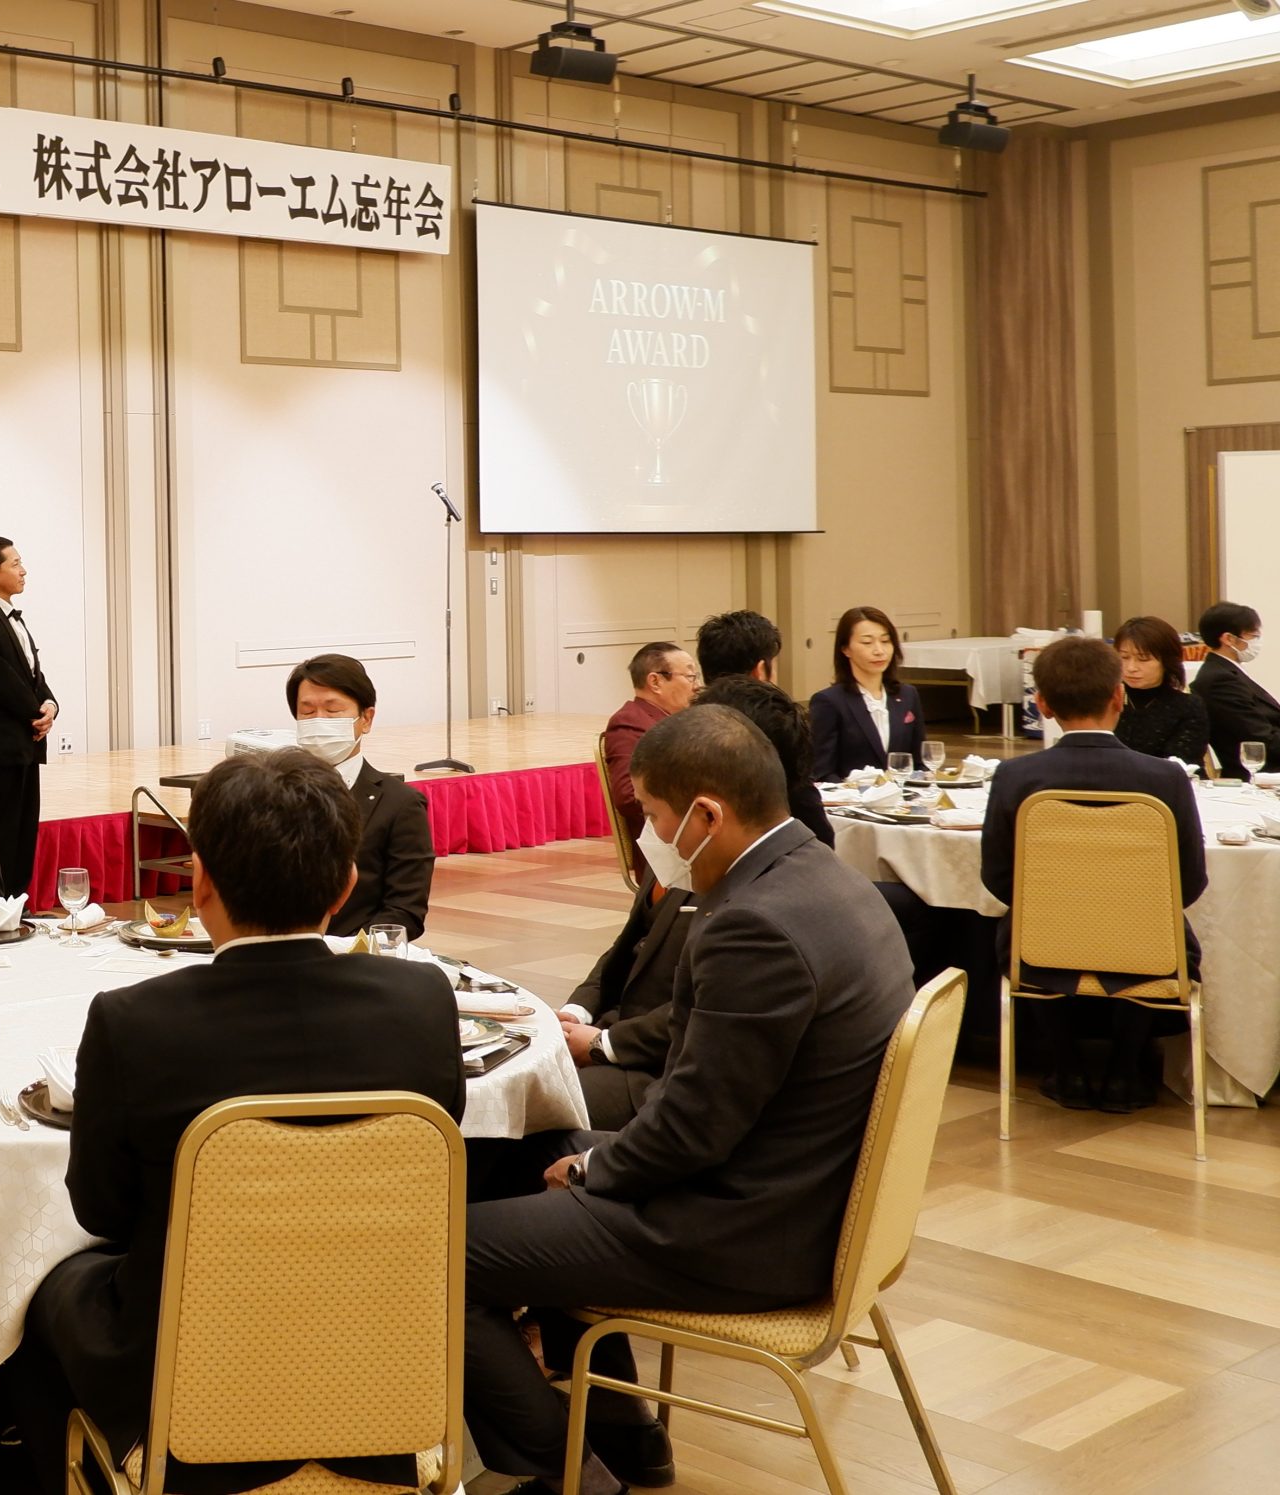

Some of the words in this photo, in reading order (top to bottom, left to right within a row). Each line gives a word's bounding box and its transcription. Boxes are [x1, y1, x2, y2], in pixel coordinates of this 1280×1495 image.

[33, 134, 445, 240] 株式会社アローエム忘年会
[588, 278, 727, 323] ARROW-M
[606, 328, 710, 369] AWARD
